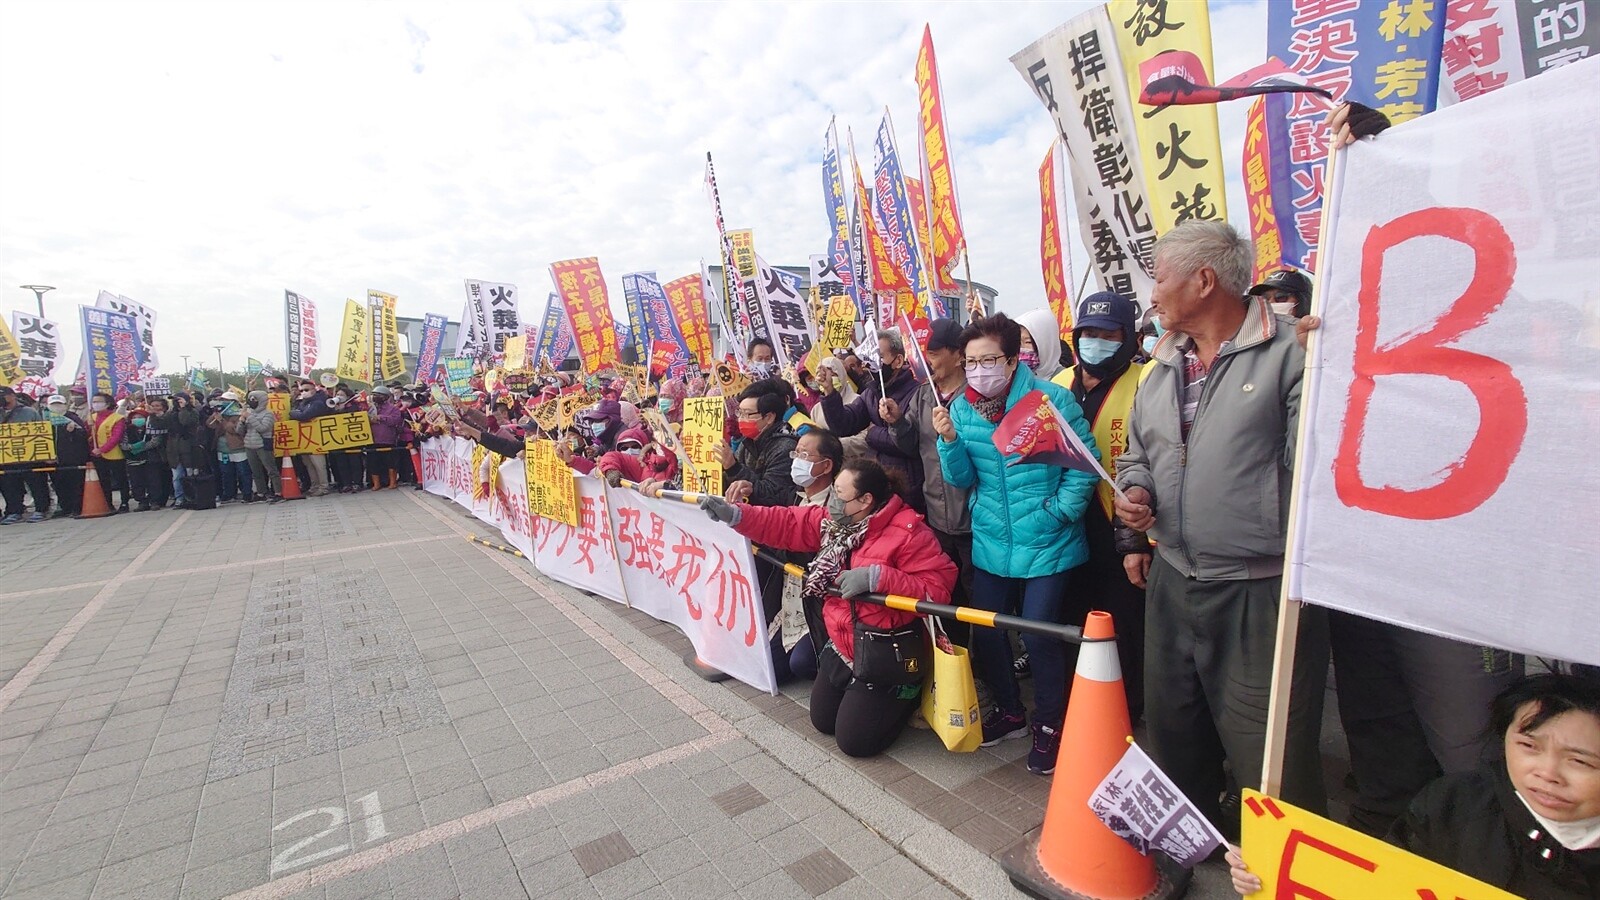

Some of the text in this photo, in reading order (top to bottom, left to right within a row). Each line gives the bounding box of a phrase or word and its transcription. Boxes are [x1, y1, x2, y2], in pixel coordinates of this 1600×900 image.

[1331, 206, 1528, 521] B
[275, 413, 370, 449] 違反民意
[271, 790, 395, 874] 21
